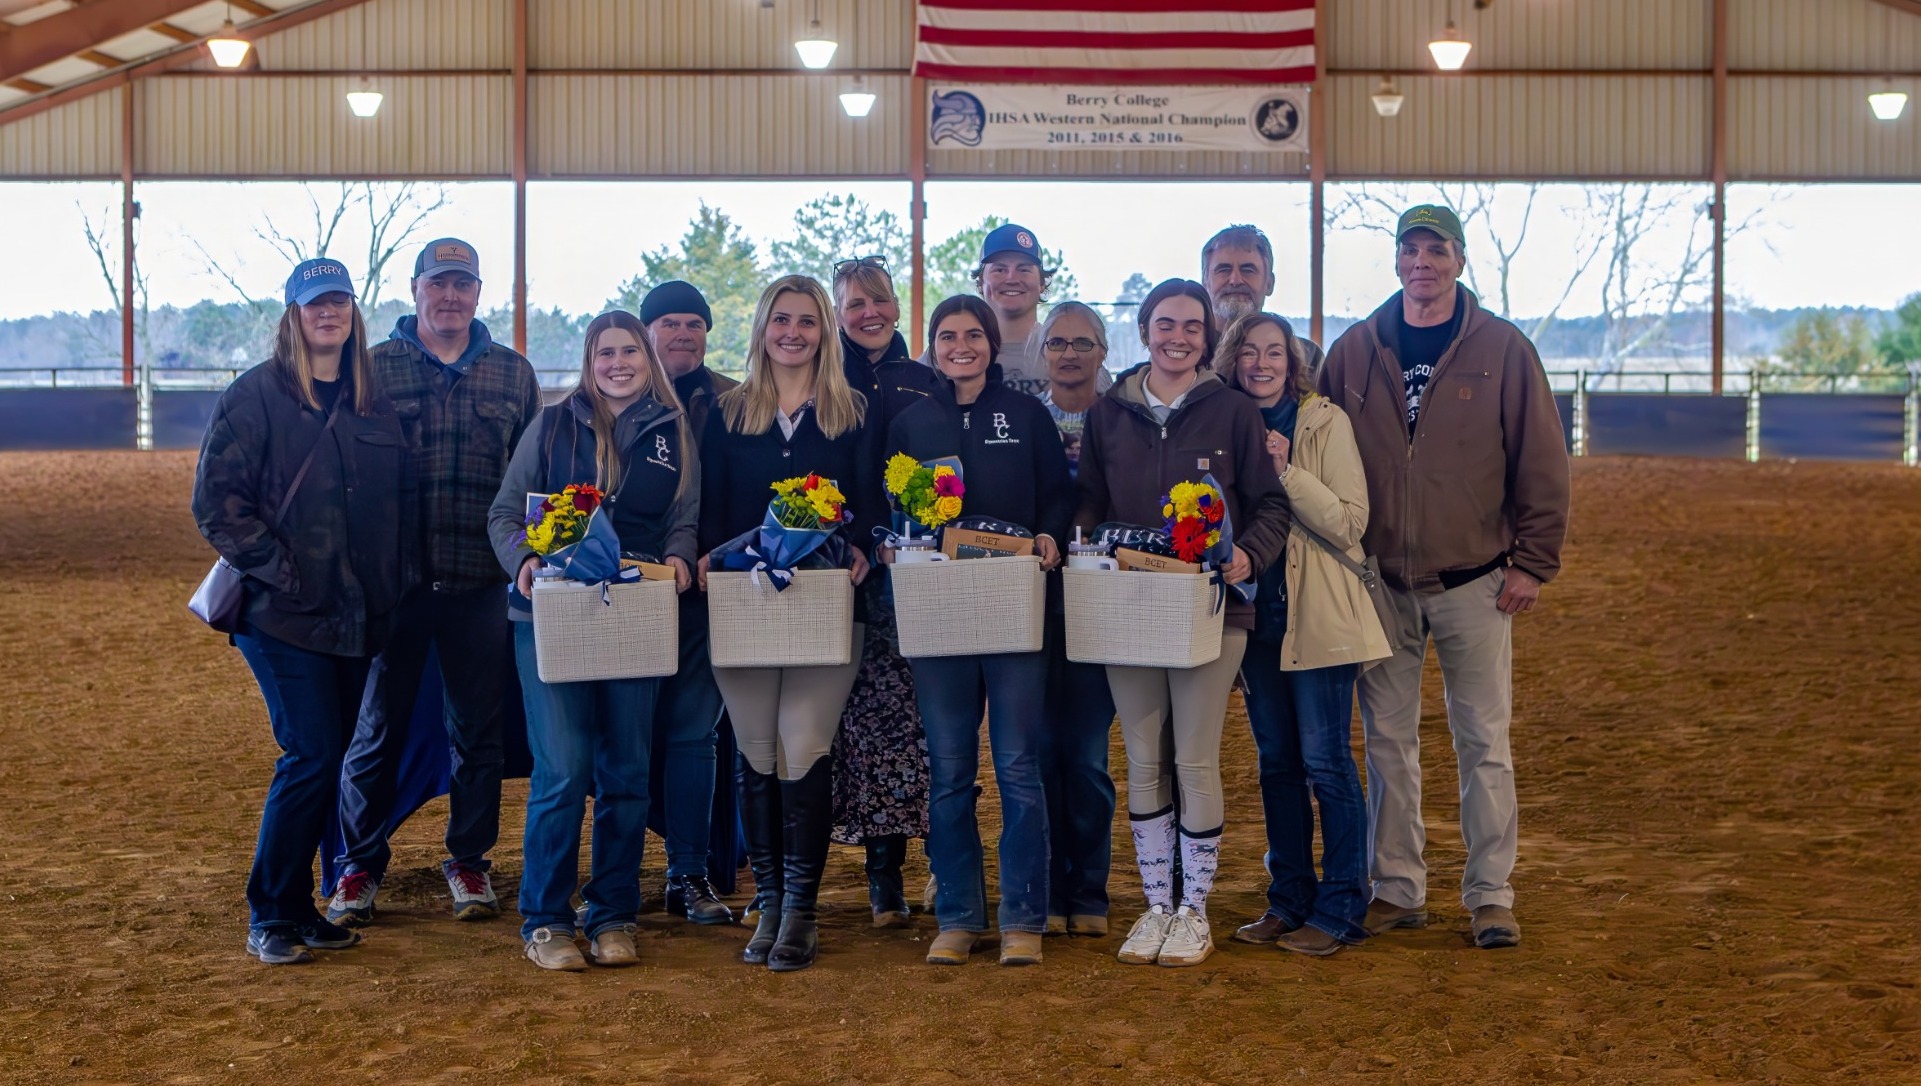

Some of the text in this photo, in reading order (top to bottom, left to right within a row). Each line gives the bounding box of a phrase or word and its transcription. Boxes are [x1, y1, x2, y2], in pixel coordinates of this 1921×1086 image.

[1066, 93, 1170, 109] Berry College
[989, 112, 1247, 128] IHSA Western National Champion
[1047, 131, 1184, 144] 2011, 2015 & 2016
[303, 265, 342, 281] BERRY
[975, 535, 1000, 546] BCET
[1144, 557, 1168, 569] BCET
